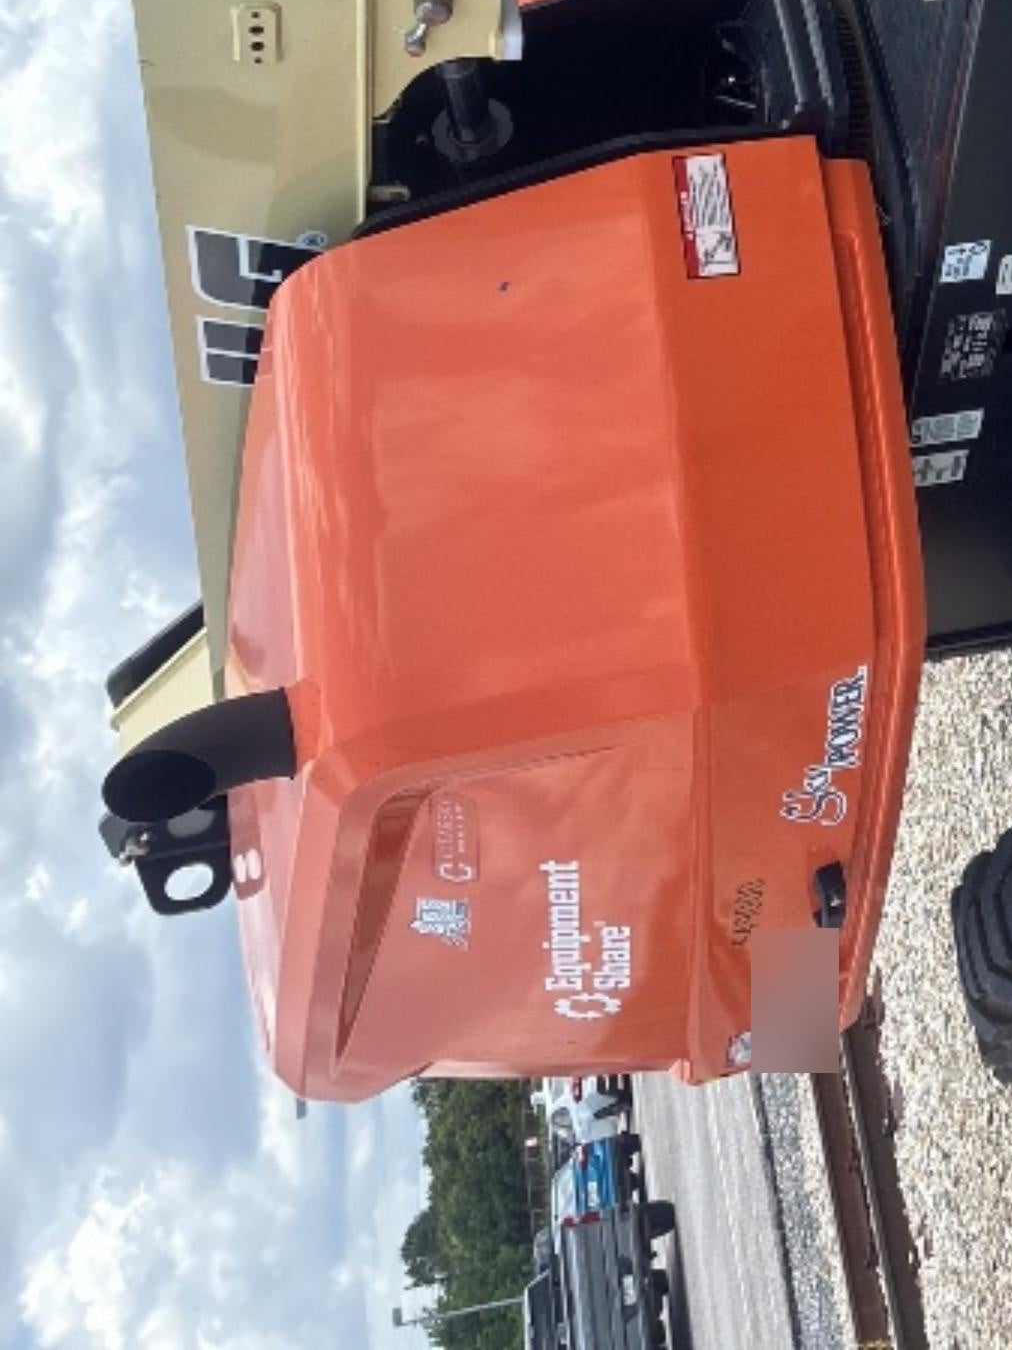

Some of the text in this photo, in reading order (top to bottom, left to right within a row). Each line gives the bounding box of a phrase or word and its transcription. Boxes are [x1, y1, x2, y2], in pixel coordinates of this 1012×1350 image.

[827, 672, 865, 768] POWER
[539, 860, 592, 991] Equipment
[592, 925, 631, 990] Share
